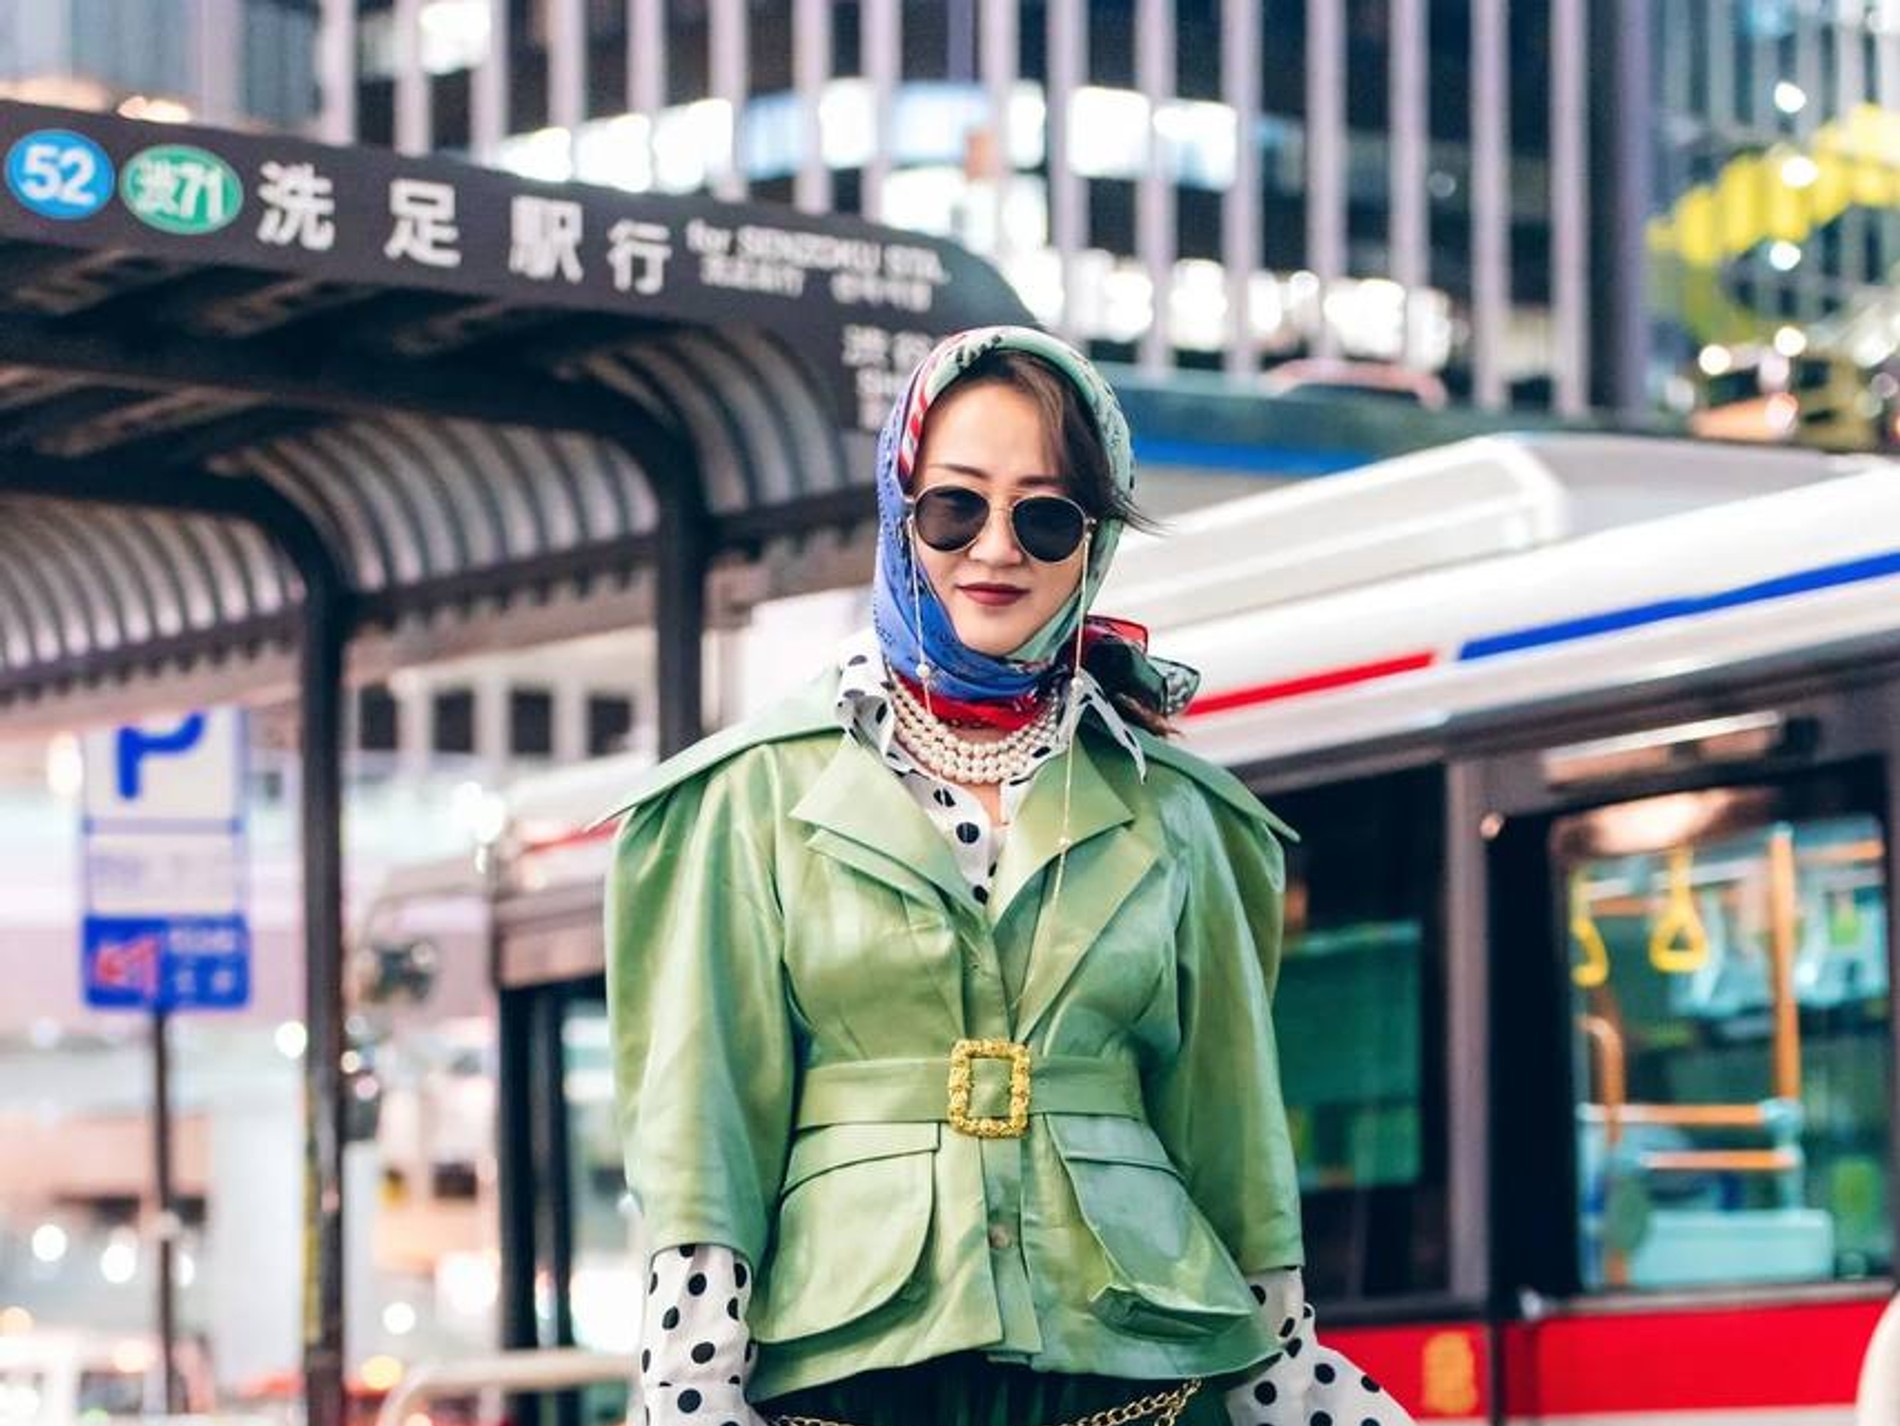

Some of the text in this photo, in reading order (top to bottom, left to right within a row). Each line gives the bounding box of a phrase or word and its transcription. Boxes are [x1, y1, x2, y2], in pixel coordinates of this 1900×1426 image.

[22, 144, 97, 205] 52
[257, 160, 672, 294] 洗足駅行
